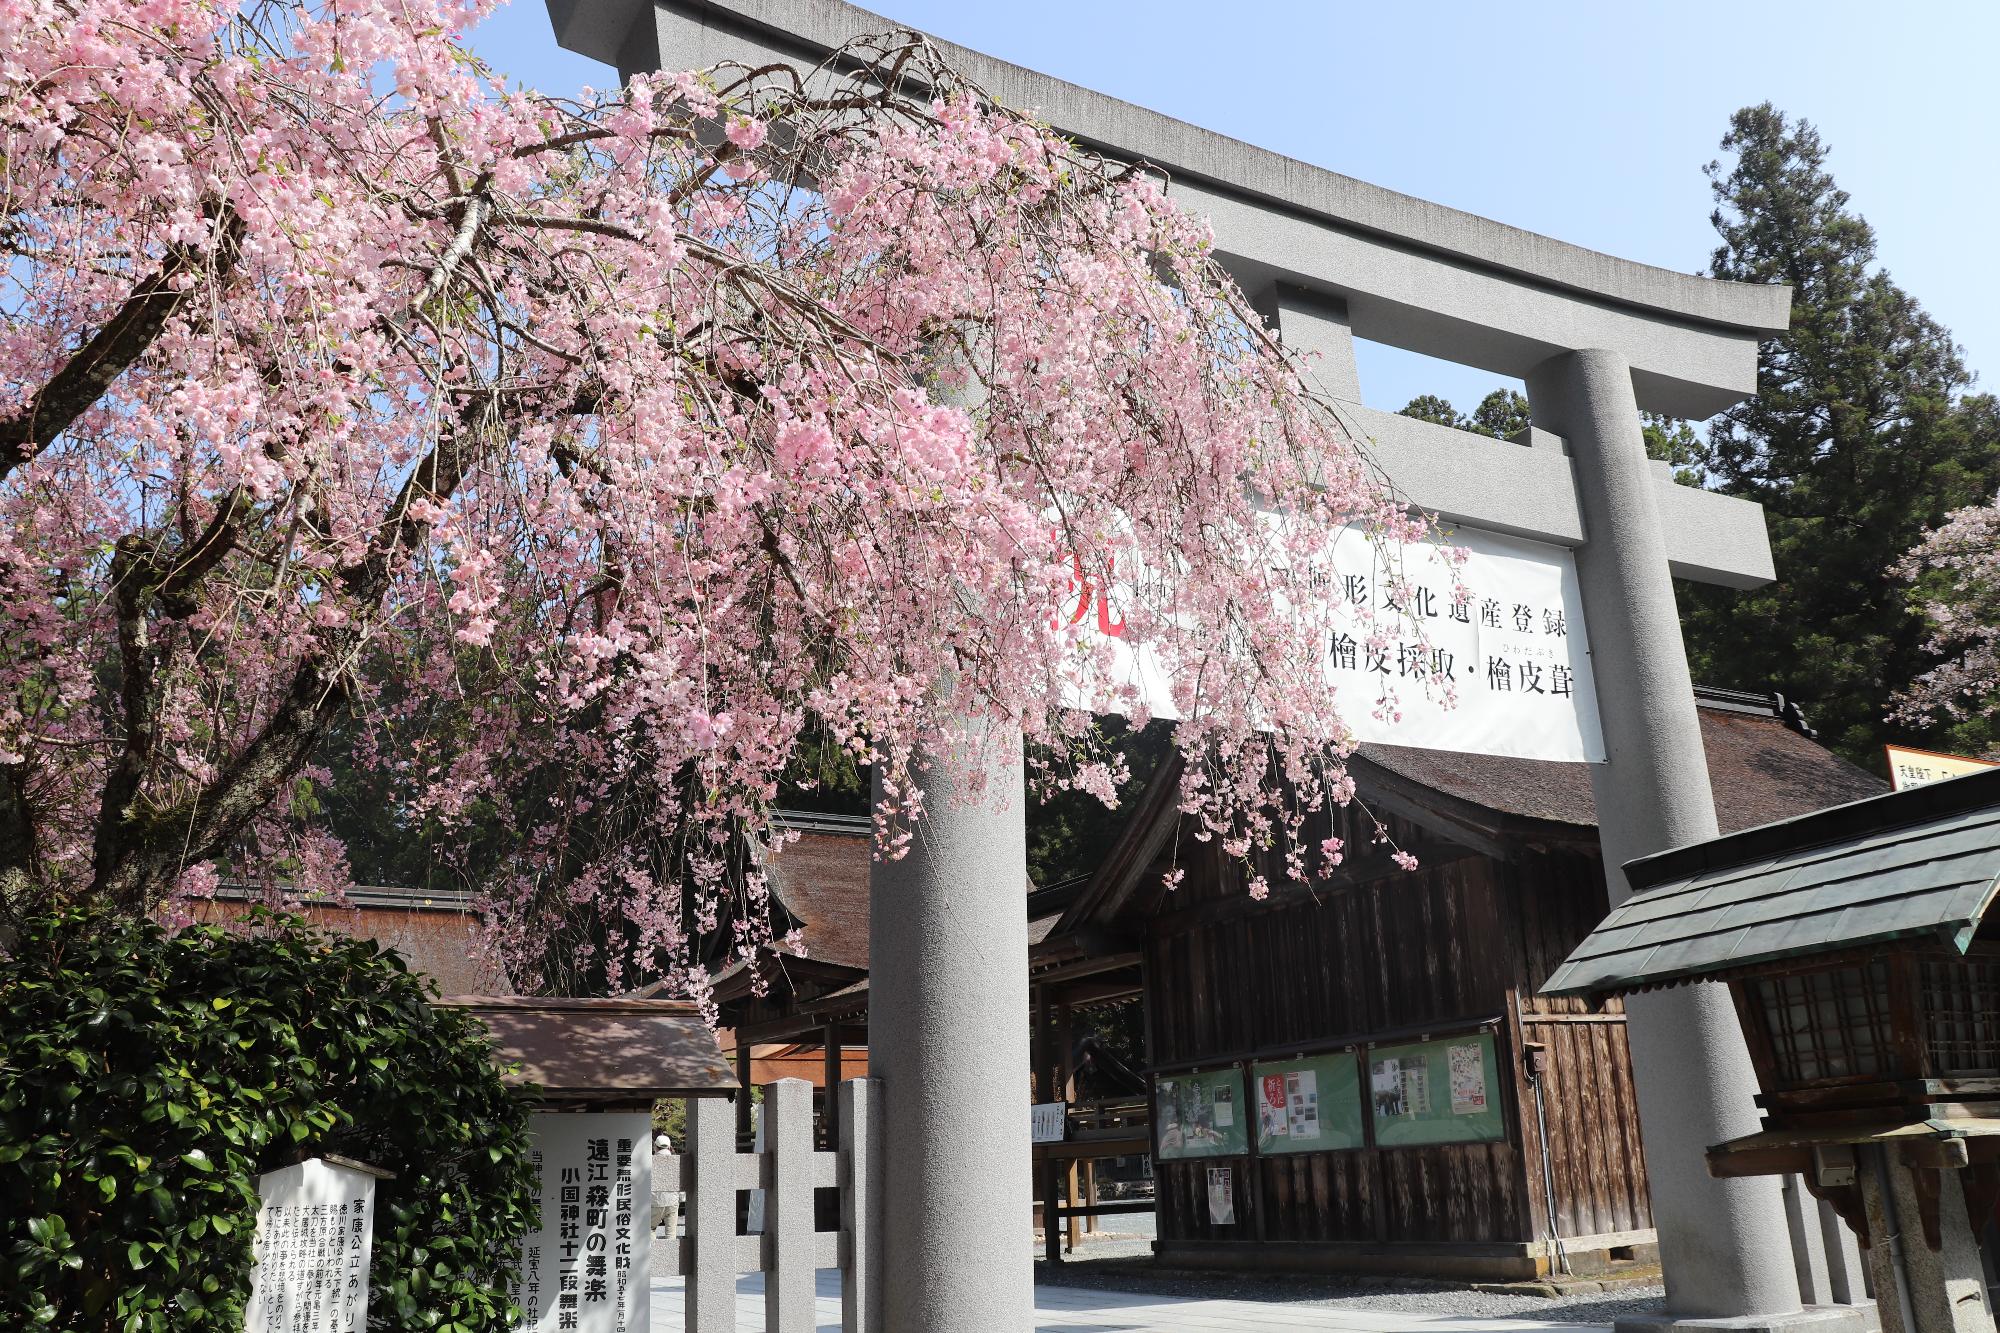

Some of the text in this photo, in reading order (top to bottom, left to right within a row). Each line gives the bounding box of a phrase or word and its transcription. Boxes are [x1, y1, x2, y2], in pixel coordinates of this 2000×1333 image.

[559, 1168, 580, 1329] 小国神社十二段舞楽
[585, 1138, 609, 1302] 遠江森町の舞楽
[616, 1138, 632, 1270] 重要無形民俗文化財
